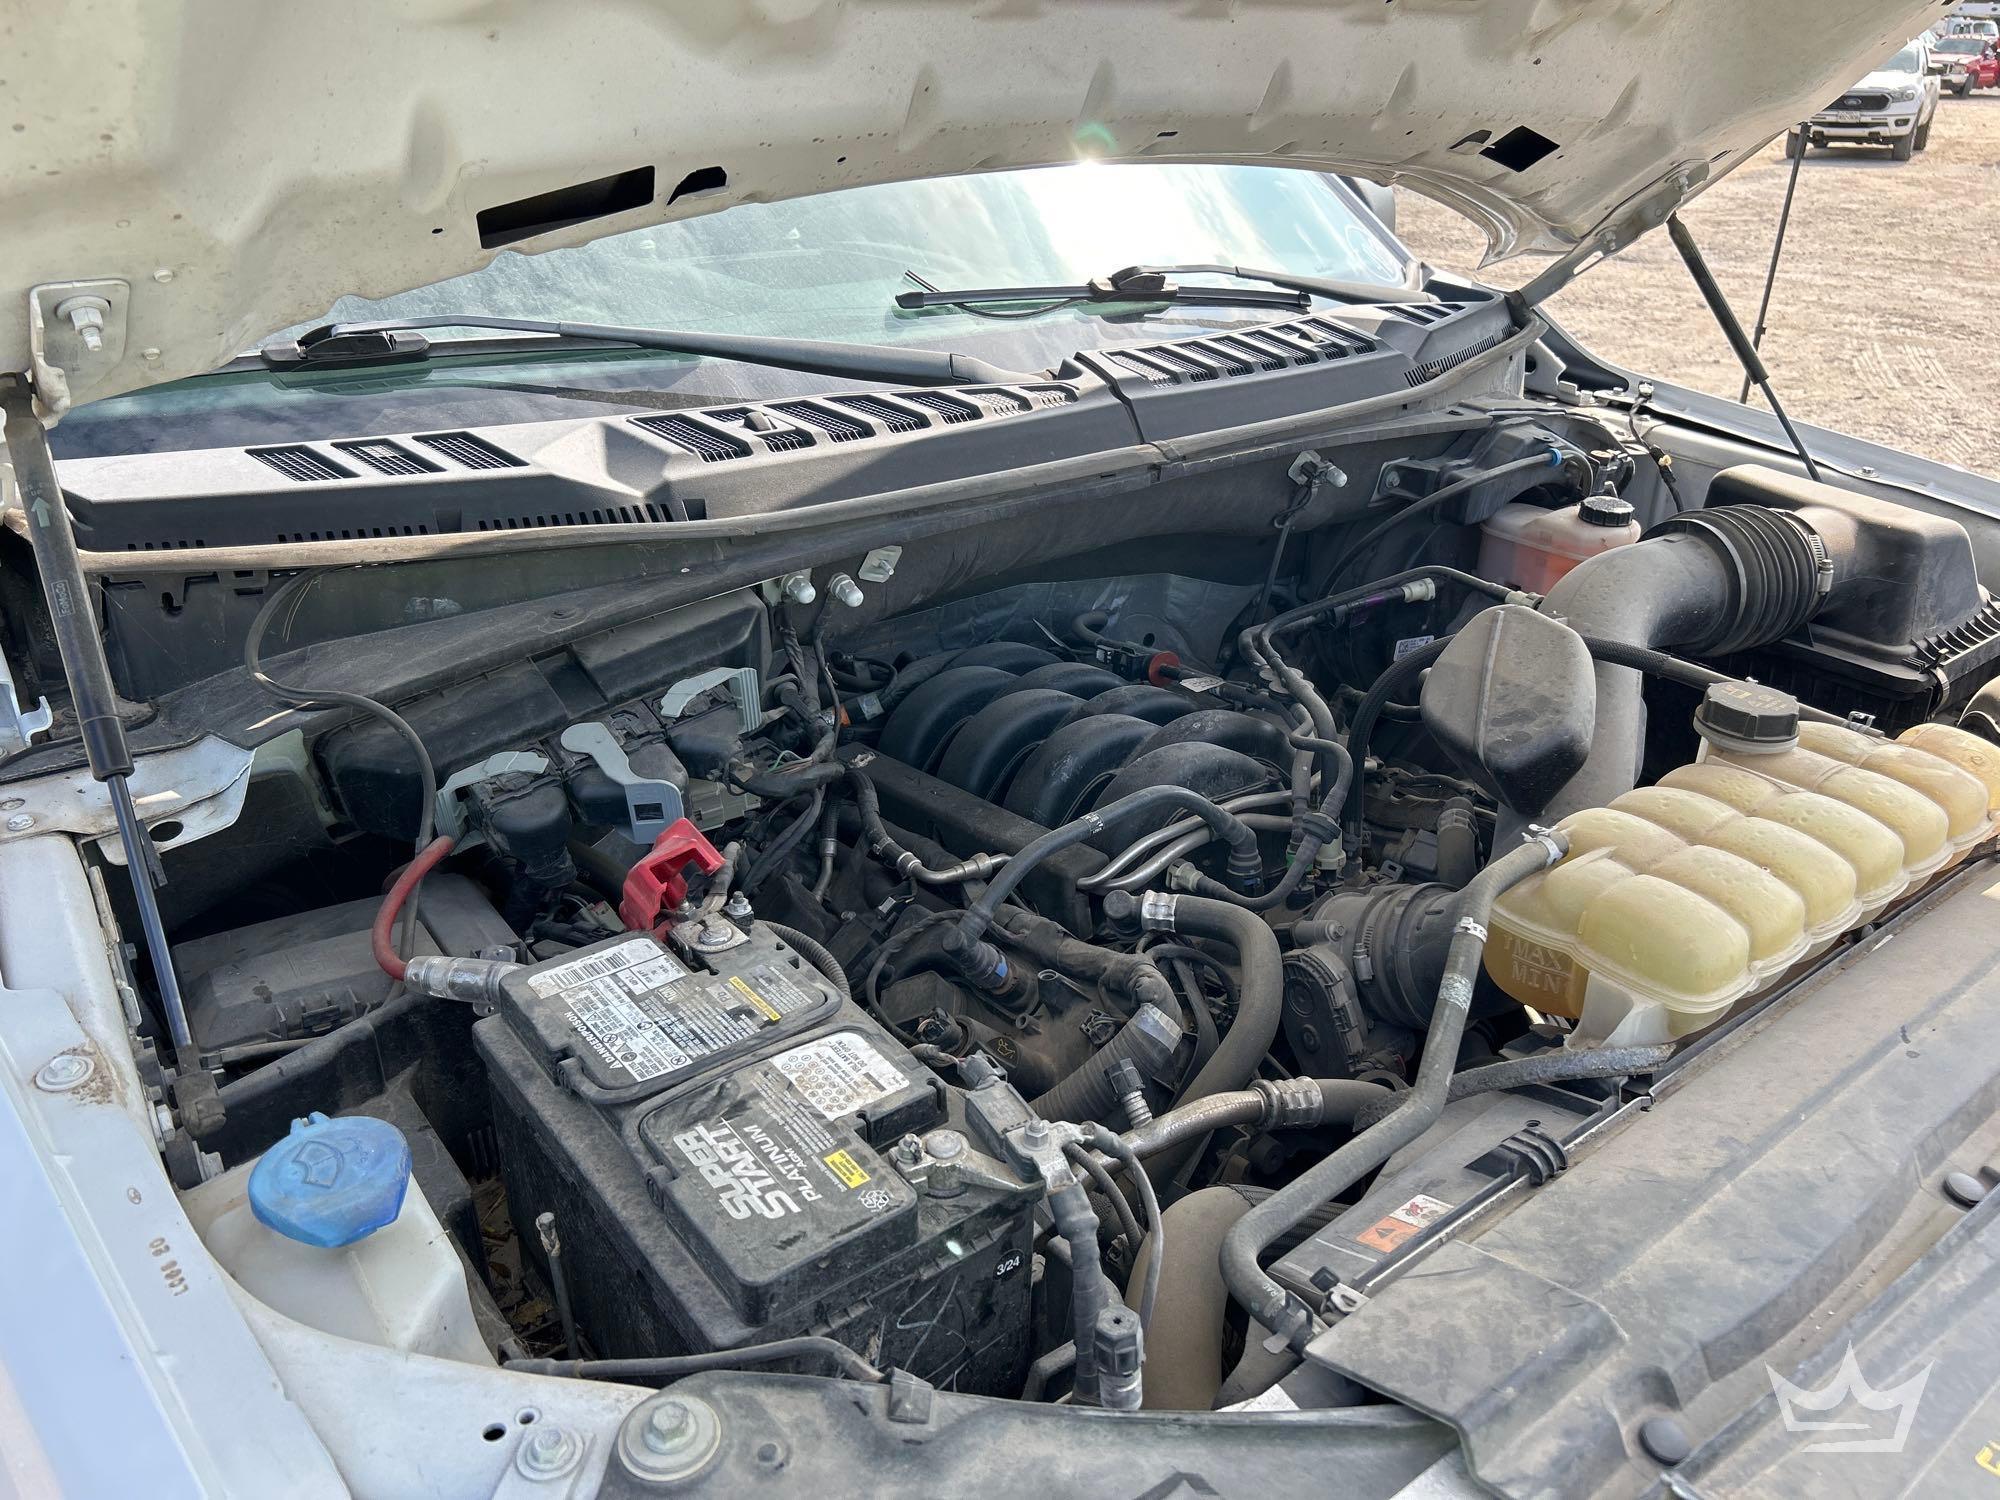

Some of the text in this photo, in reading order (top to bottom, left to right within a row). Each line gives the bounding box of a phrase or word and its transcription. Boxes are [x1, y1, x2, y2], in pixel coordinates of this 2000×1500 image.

[56, 583, 71, 614] FoMoCo
[1513, 938, 1562, 970] MAX
[1512, 961, 1560, 994] MIN
[563, 1011, 615, 1062] DANGER/POISON
[829, 1044, 850, 1061] BATTERY
[696, 1127, 801, 1220] START
[746, 1124, 823, 1201] PLATINUM
[784, 1147, 807, 1168] AGM
[673, 1129, 765, 1221] SUPER
[996, 1256, 1020, 1276] 3/24
